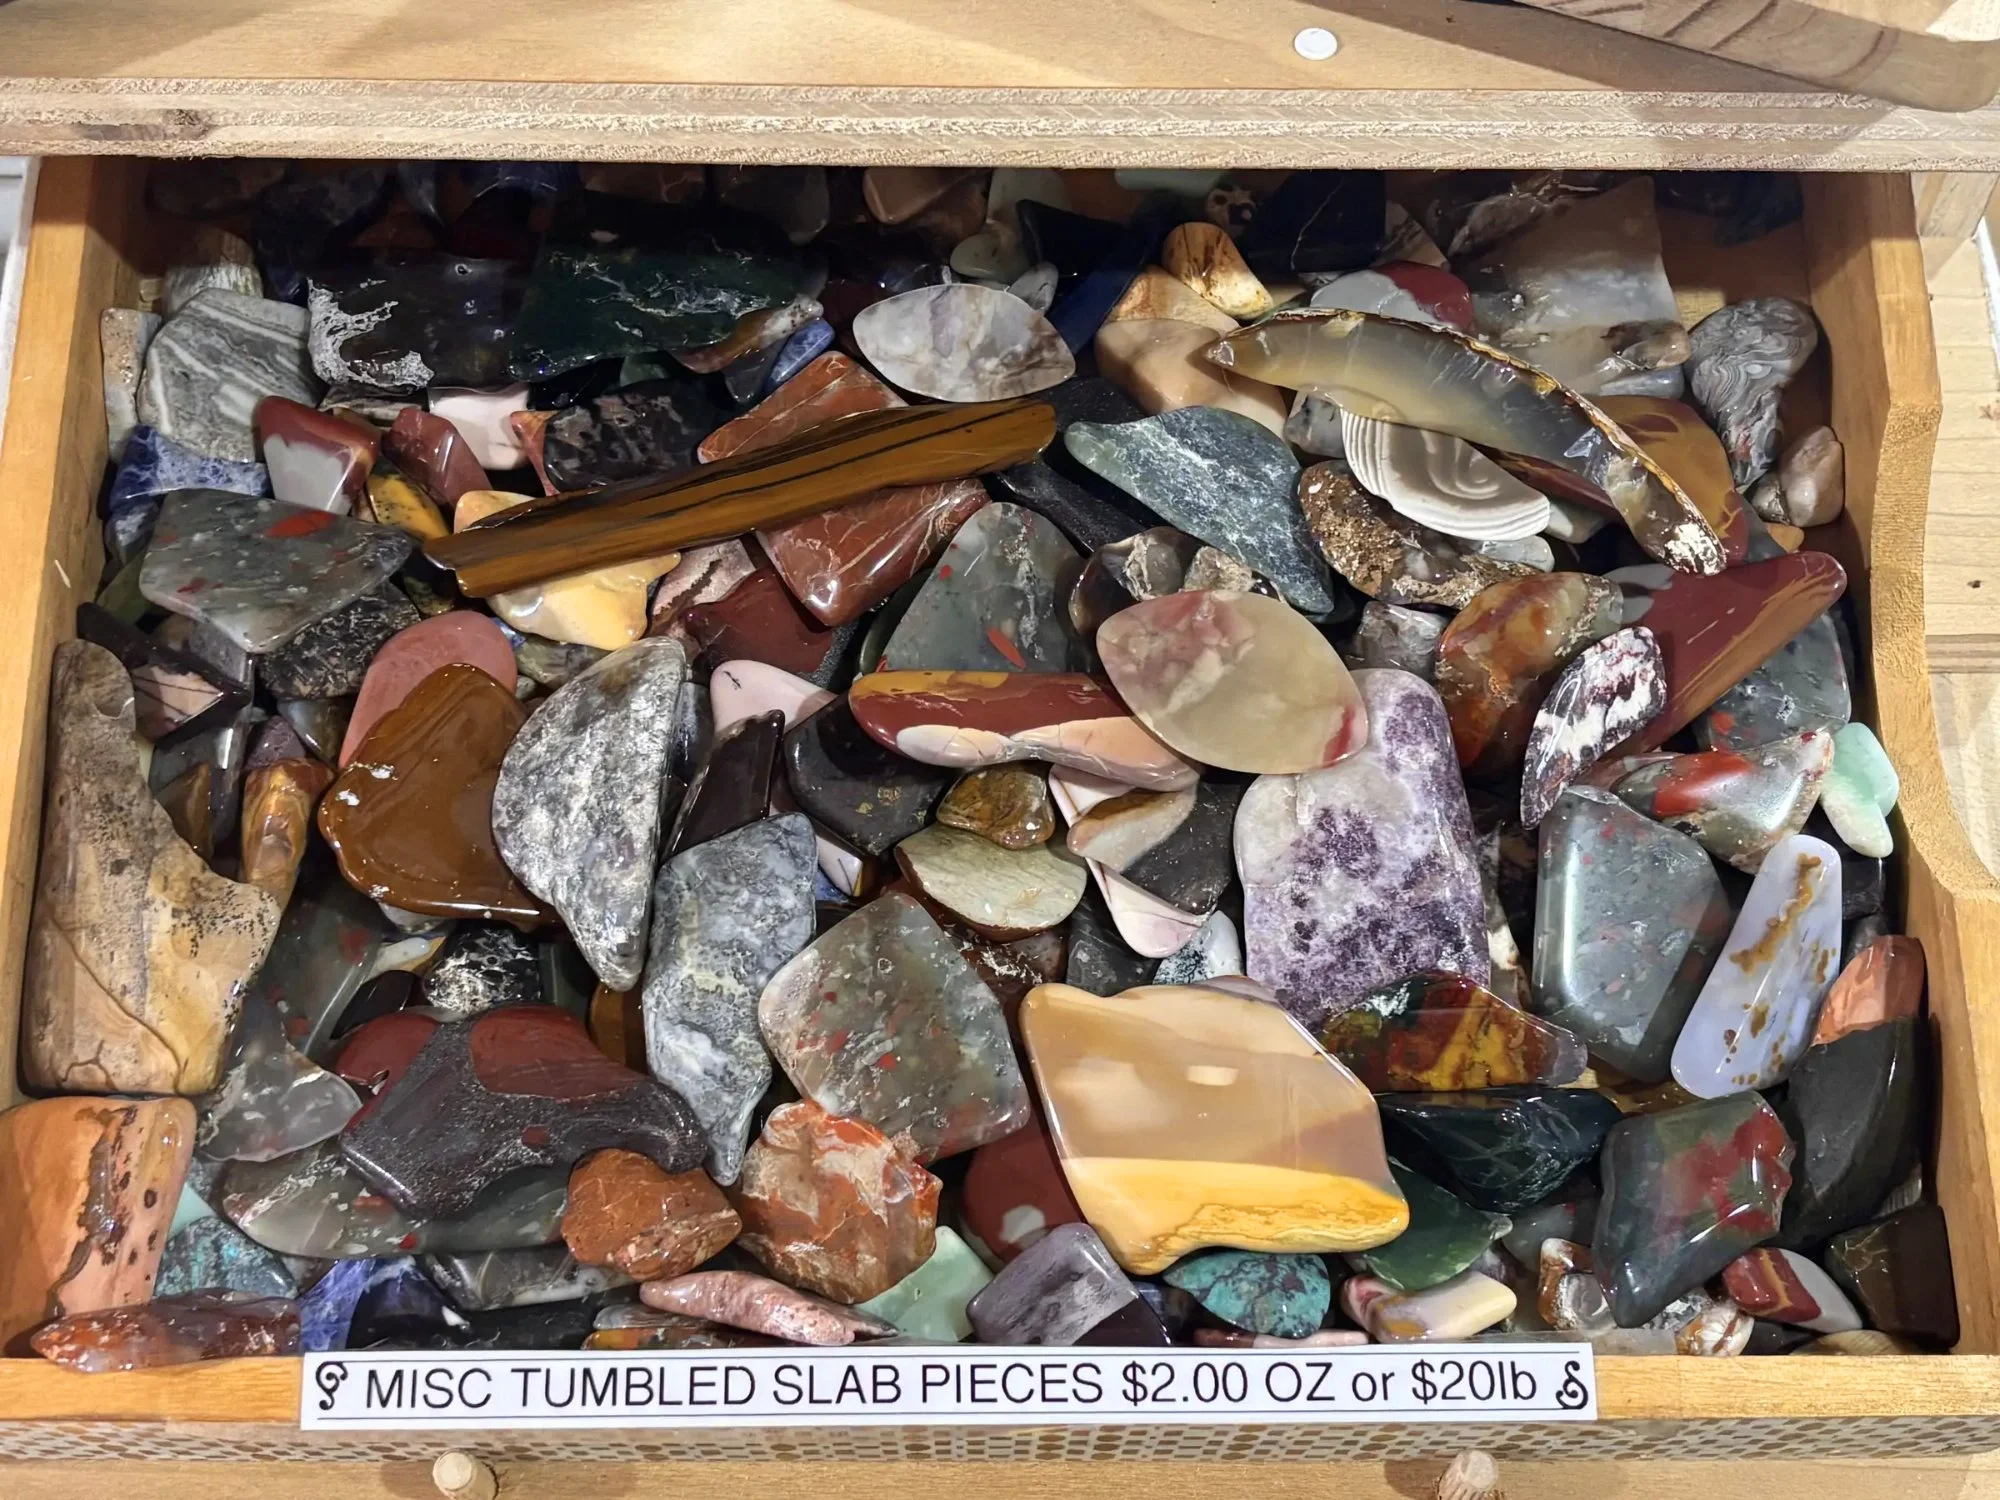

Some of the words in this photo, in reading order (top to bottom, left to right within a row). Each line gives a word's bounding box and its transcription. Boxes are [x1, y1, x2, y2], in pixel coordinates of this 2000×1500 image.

[366, 1367, 492, 1409] MISC
[510, 1364, 756, 1408] TUMBLED
[773, 1363, 902, 1405] SLAB
[922, 1361, 1103, 1404] PIECES
[1121, 1360, 1249, 1407] $2.00
[1264, 1360, 1335, 1403] OZ
[1351, 1371, 1396, 1402] or
[1411, 1358, 1538, 1405] $20lb
